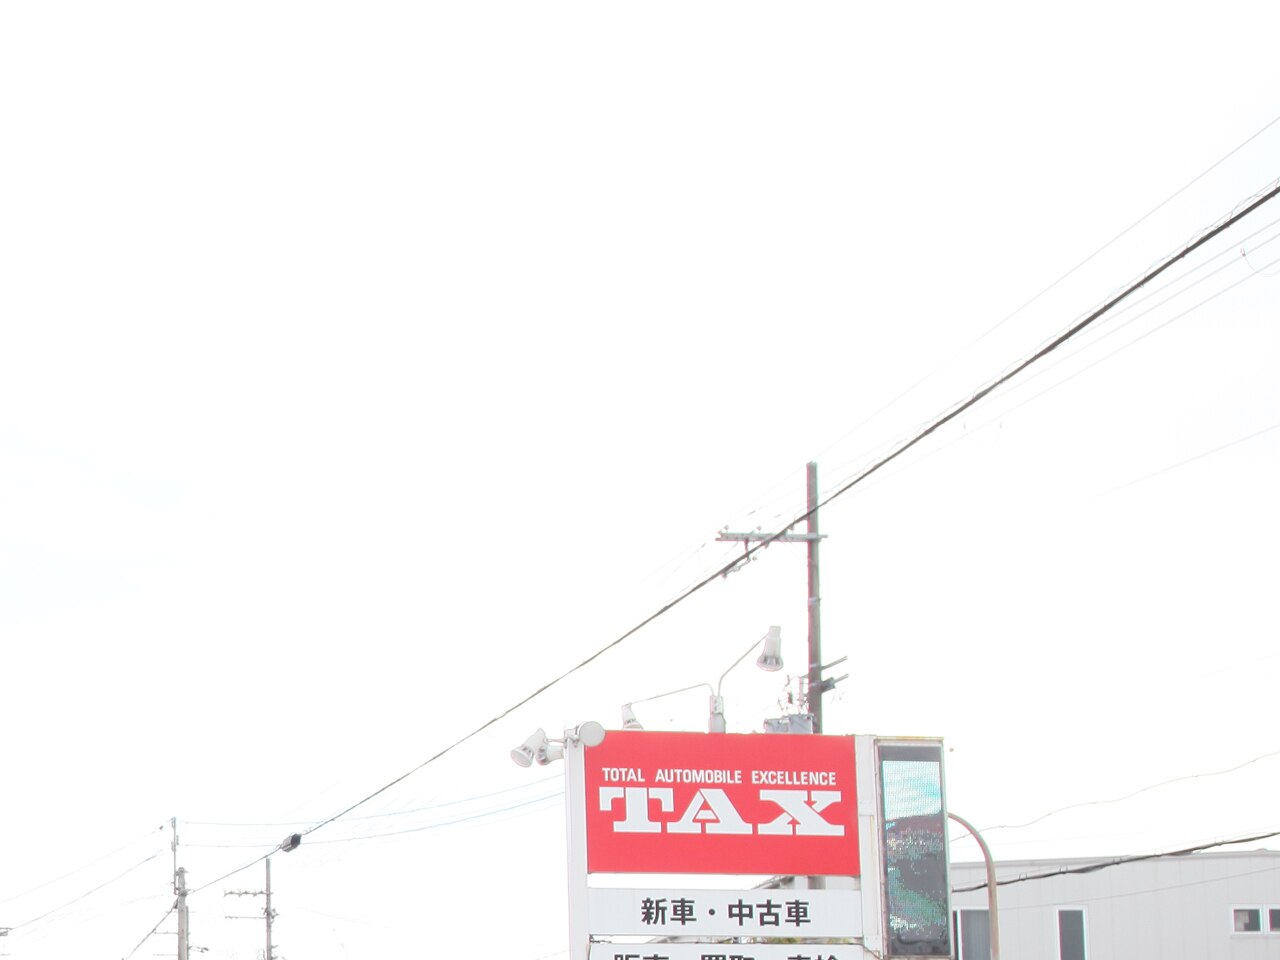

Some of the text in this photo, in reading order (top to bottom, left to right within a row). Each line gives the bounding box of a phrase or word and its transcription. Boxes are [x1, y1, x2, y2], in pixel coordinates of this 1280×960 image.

[602, 768, 837, 786] TOTAL AUTOMOBILE EXCELLENCE
[599, 787, 846, 837] TAX
[641, 898, 811, 927] 新車・中古車
